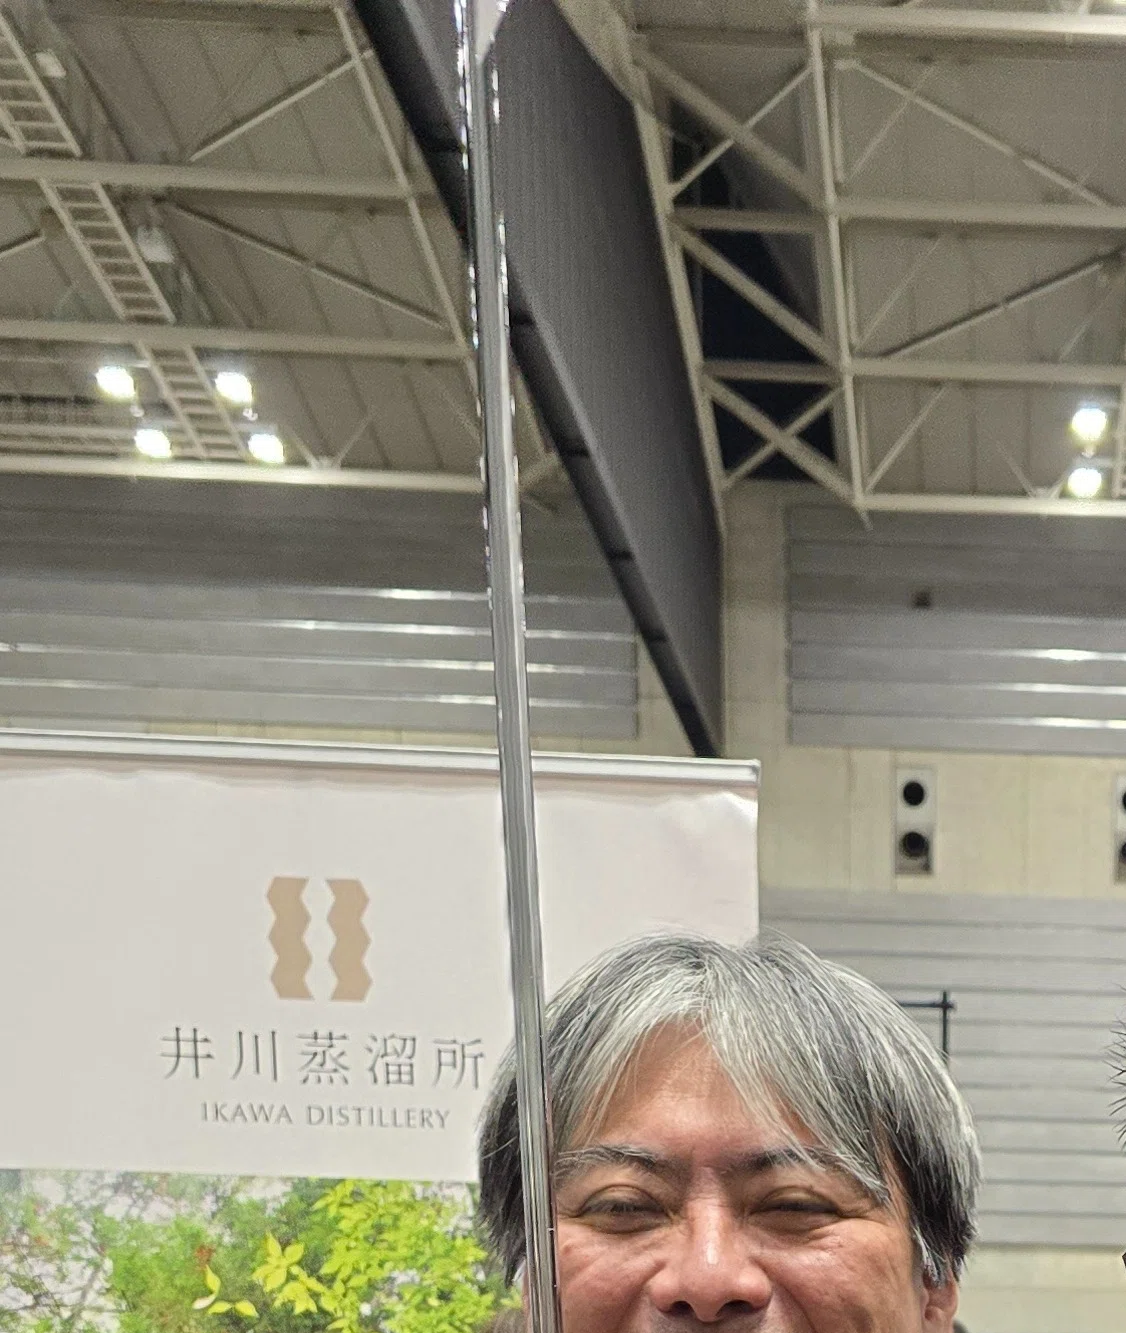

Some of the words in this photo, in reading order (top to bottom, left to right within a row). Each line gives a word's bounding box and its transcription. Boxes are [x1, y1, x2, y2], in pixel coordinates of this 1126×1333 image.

[161, 1027, 484, 1089] 井川蒸溜所
[201, 1101, 293, 1124] IKAWA
[306, 1104, 450, 1129] DISTILLERY
